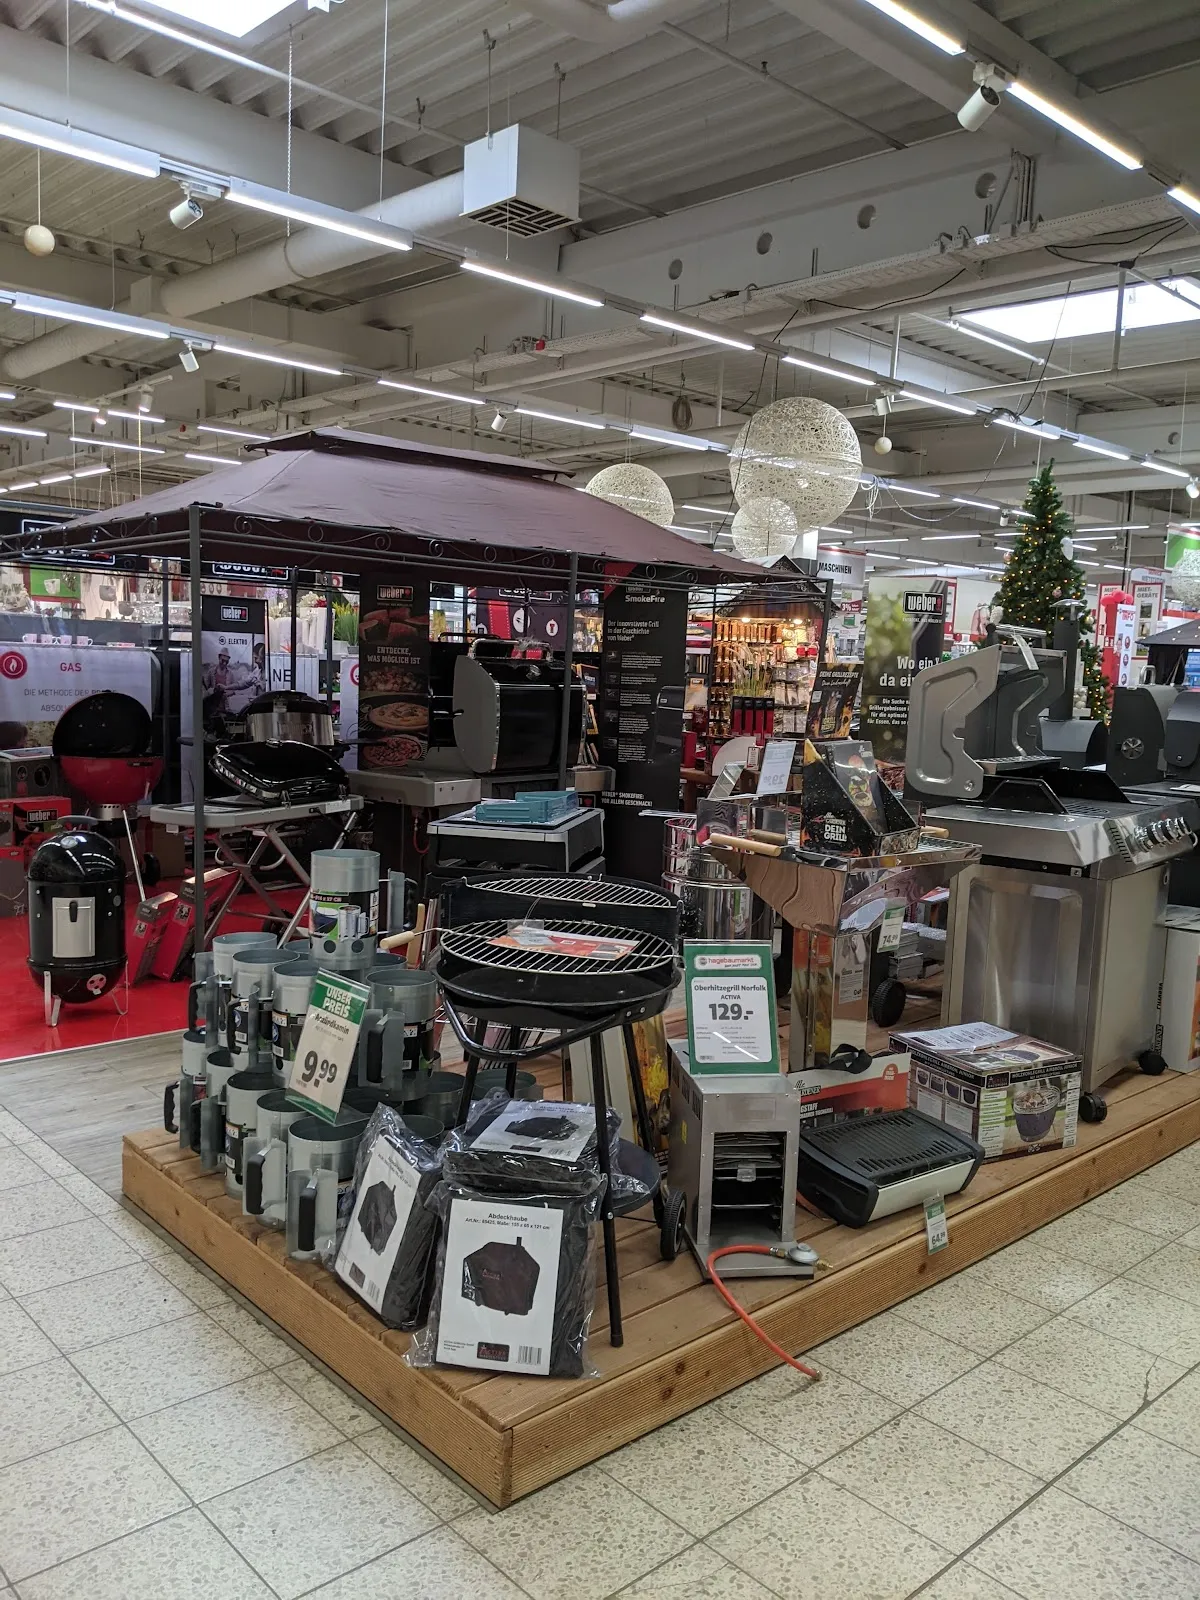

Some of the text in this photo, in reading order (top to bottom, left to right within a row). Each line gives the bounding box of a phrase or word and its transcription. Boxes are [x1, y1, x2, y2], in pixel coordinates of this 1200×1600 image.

[819, 562, 852, 575] MASCHINEN
[380, 586, 404, 599] weber
[625, 594, 666, 603] SmokeFire
[907, 593, 936, 611] weber
[223, 606, 242, 619] weber
[377, 646, 411, 656] ENTDECKE,
[367, 654, 421, 665] WAS MÖGLICH IST
[897, 656, 915, 670] Wo
[60, 662, 82, 672] GAS
[880, 673, 896, 686] da
[38, 689, 73, 697] METHODE
[29, 810, 51, 821] weber
[825, 824, 846, 833] DEIN
[694, 984, 740, 993] Oberhitzegrill
[326, 986, 352, 1005] UNSER
[323, 996, 351, 1018] PREIS
[708, 1003, 754, 1020] 129.-
[301, 1050, 338, 1088] 9.99
[488, 1213, 528, 1222] Abdeckhaube
